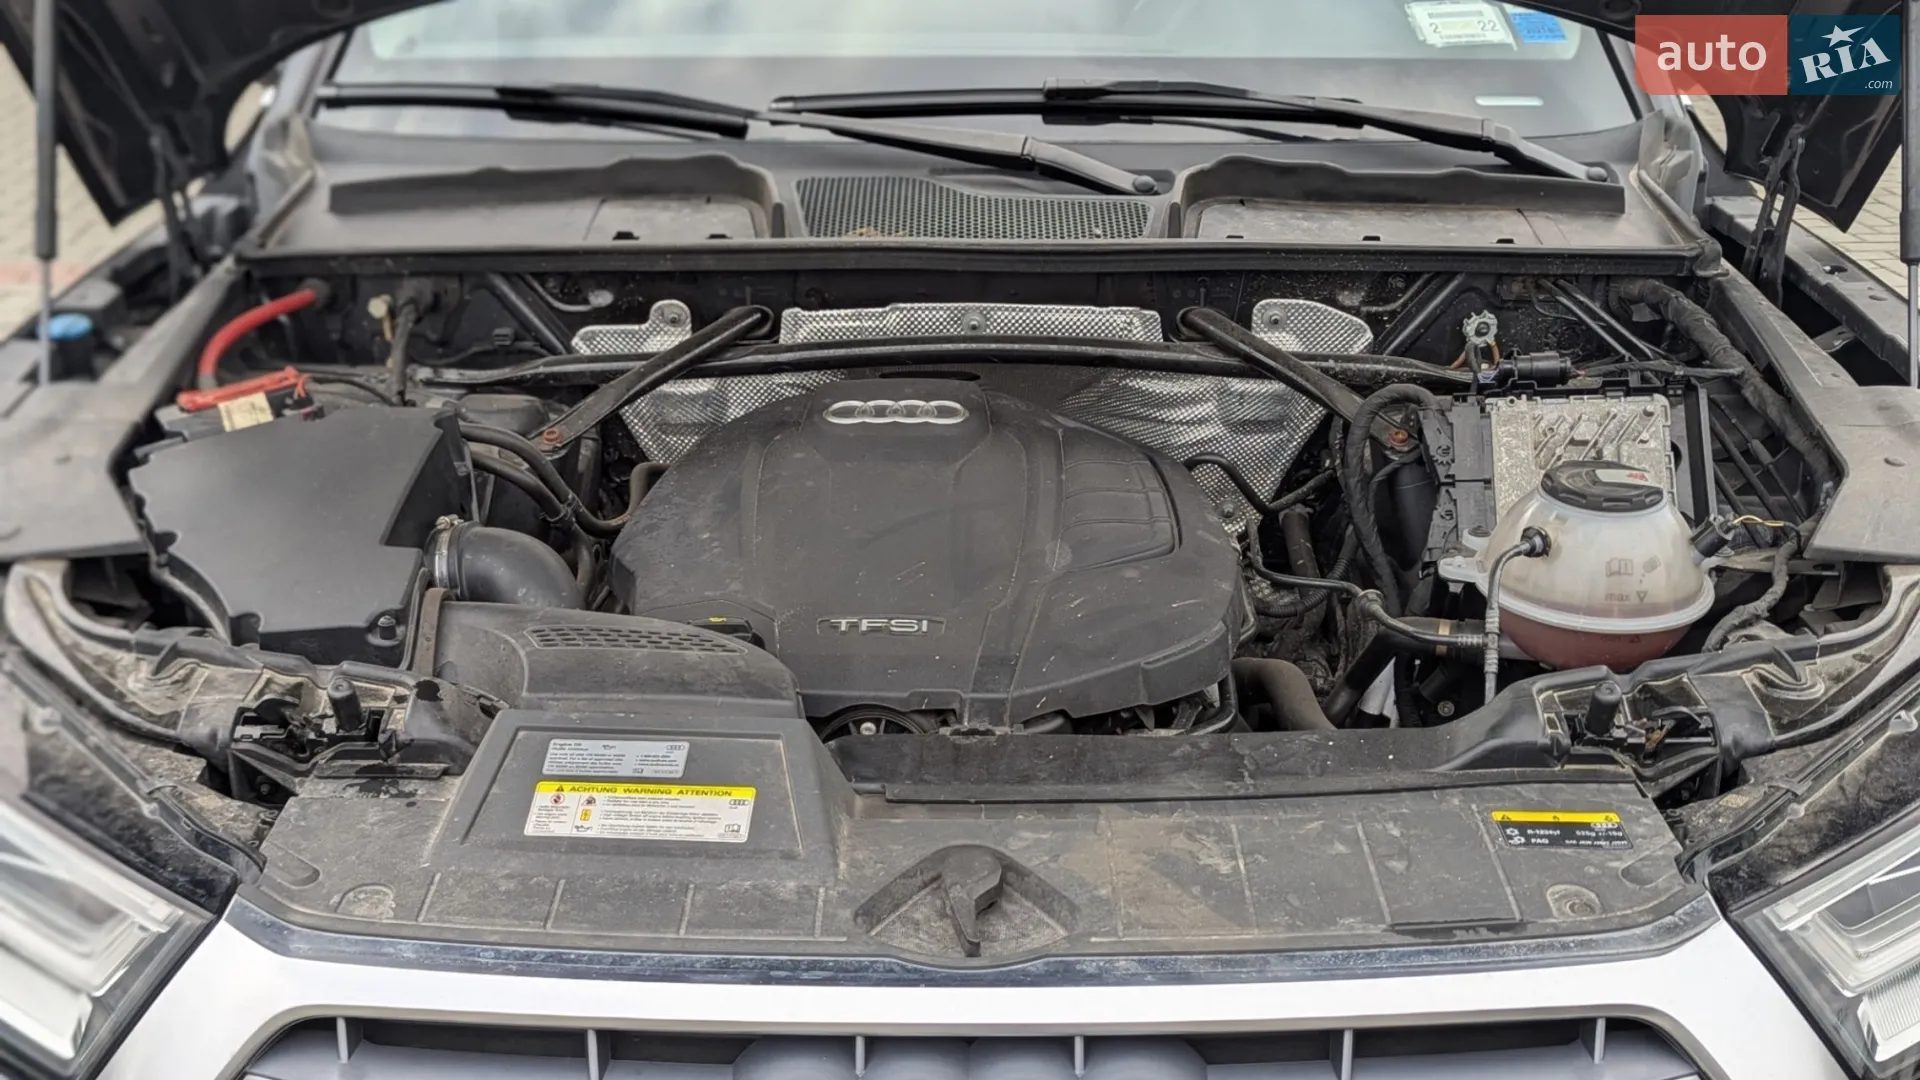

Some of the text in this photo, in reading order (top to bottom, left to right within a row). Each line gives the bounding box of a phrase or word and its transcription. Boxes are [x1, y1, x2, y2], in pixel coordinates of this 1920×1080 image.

[1476, 20, 1499, 32] 22
[1605, 592, 1630, 601] max
[830, 619, 928, 633] TFSI
[623, 787, 671, 795] WARNING
